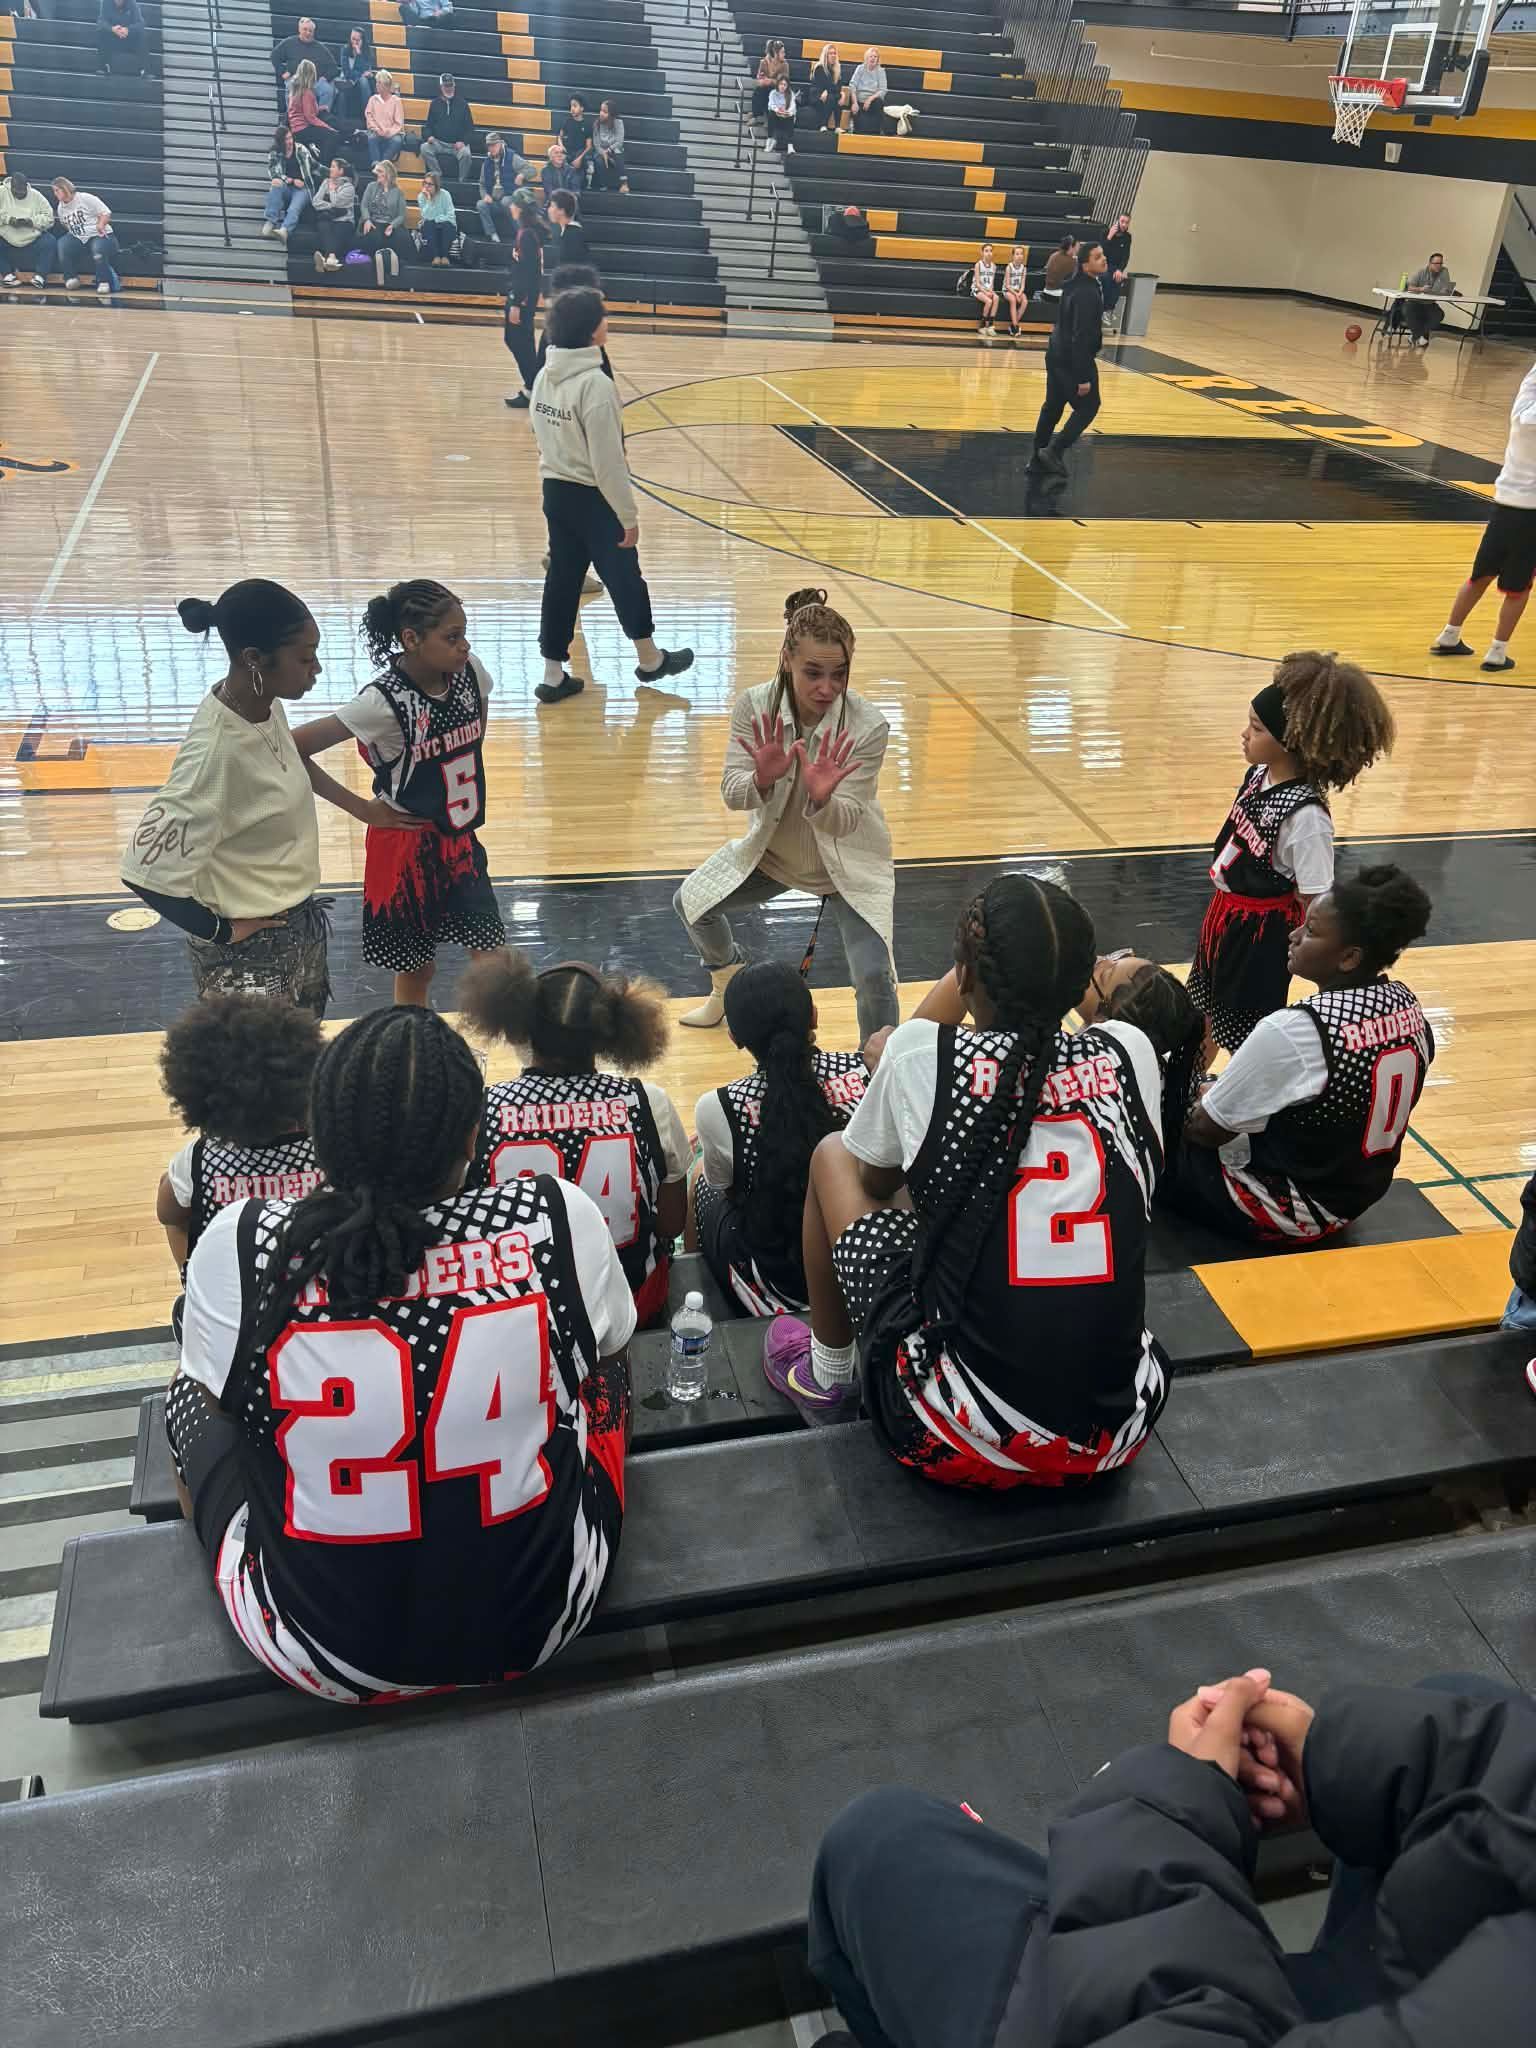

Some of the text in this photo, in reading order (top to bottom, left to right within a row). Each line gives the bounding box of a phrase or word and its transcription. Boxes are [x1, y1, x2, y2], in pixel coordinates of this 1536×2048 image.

[440, 751, 480, 830] 5
[1341, 1007, 1425, 1052] RAIDERS
[970, 1056, 1120, 1109] RERS
[1361, 1039, 1419, 1160] 0
[499, 1099, 629, 1133] RAIDERS
[212, 1169, 325, 1203] RAIDER
[1007, 1111, 1115, 1287] 2
[266, 1290, 558, 1545] 24
